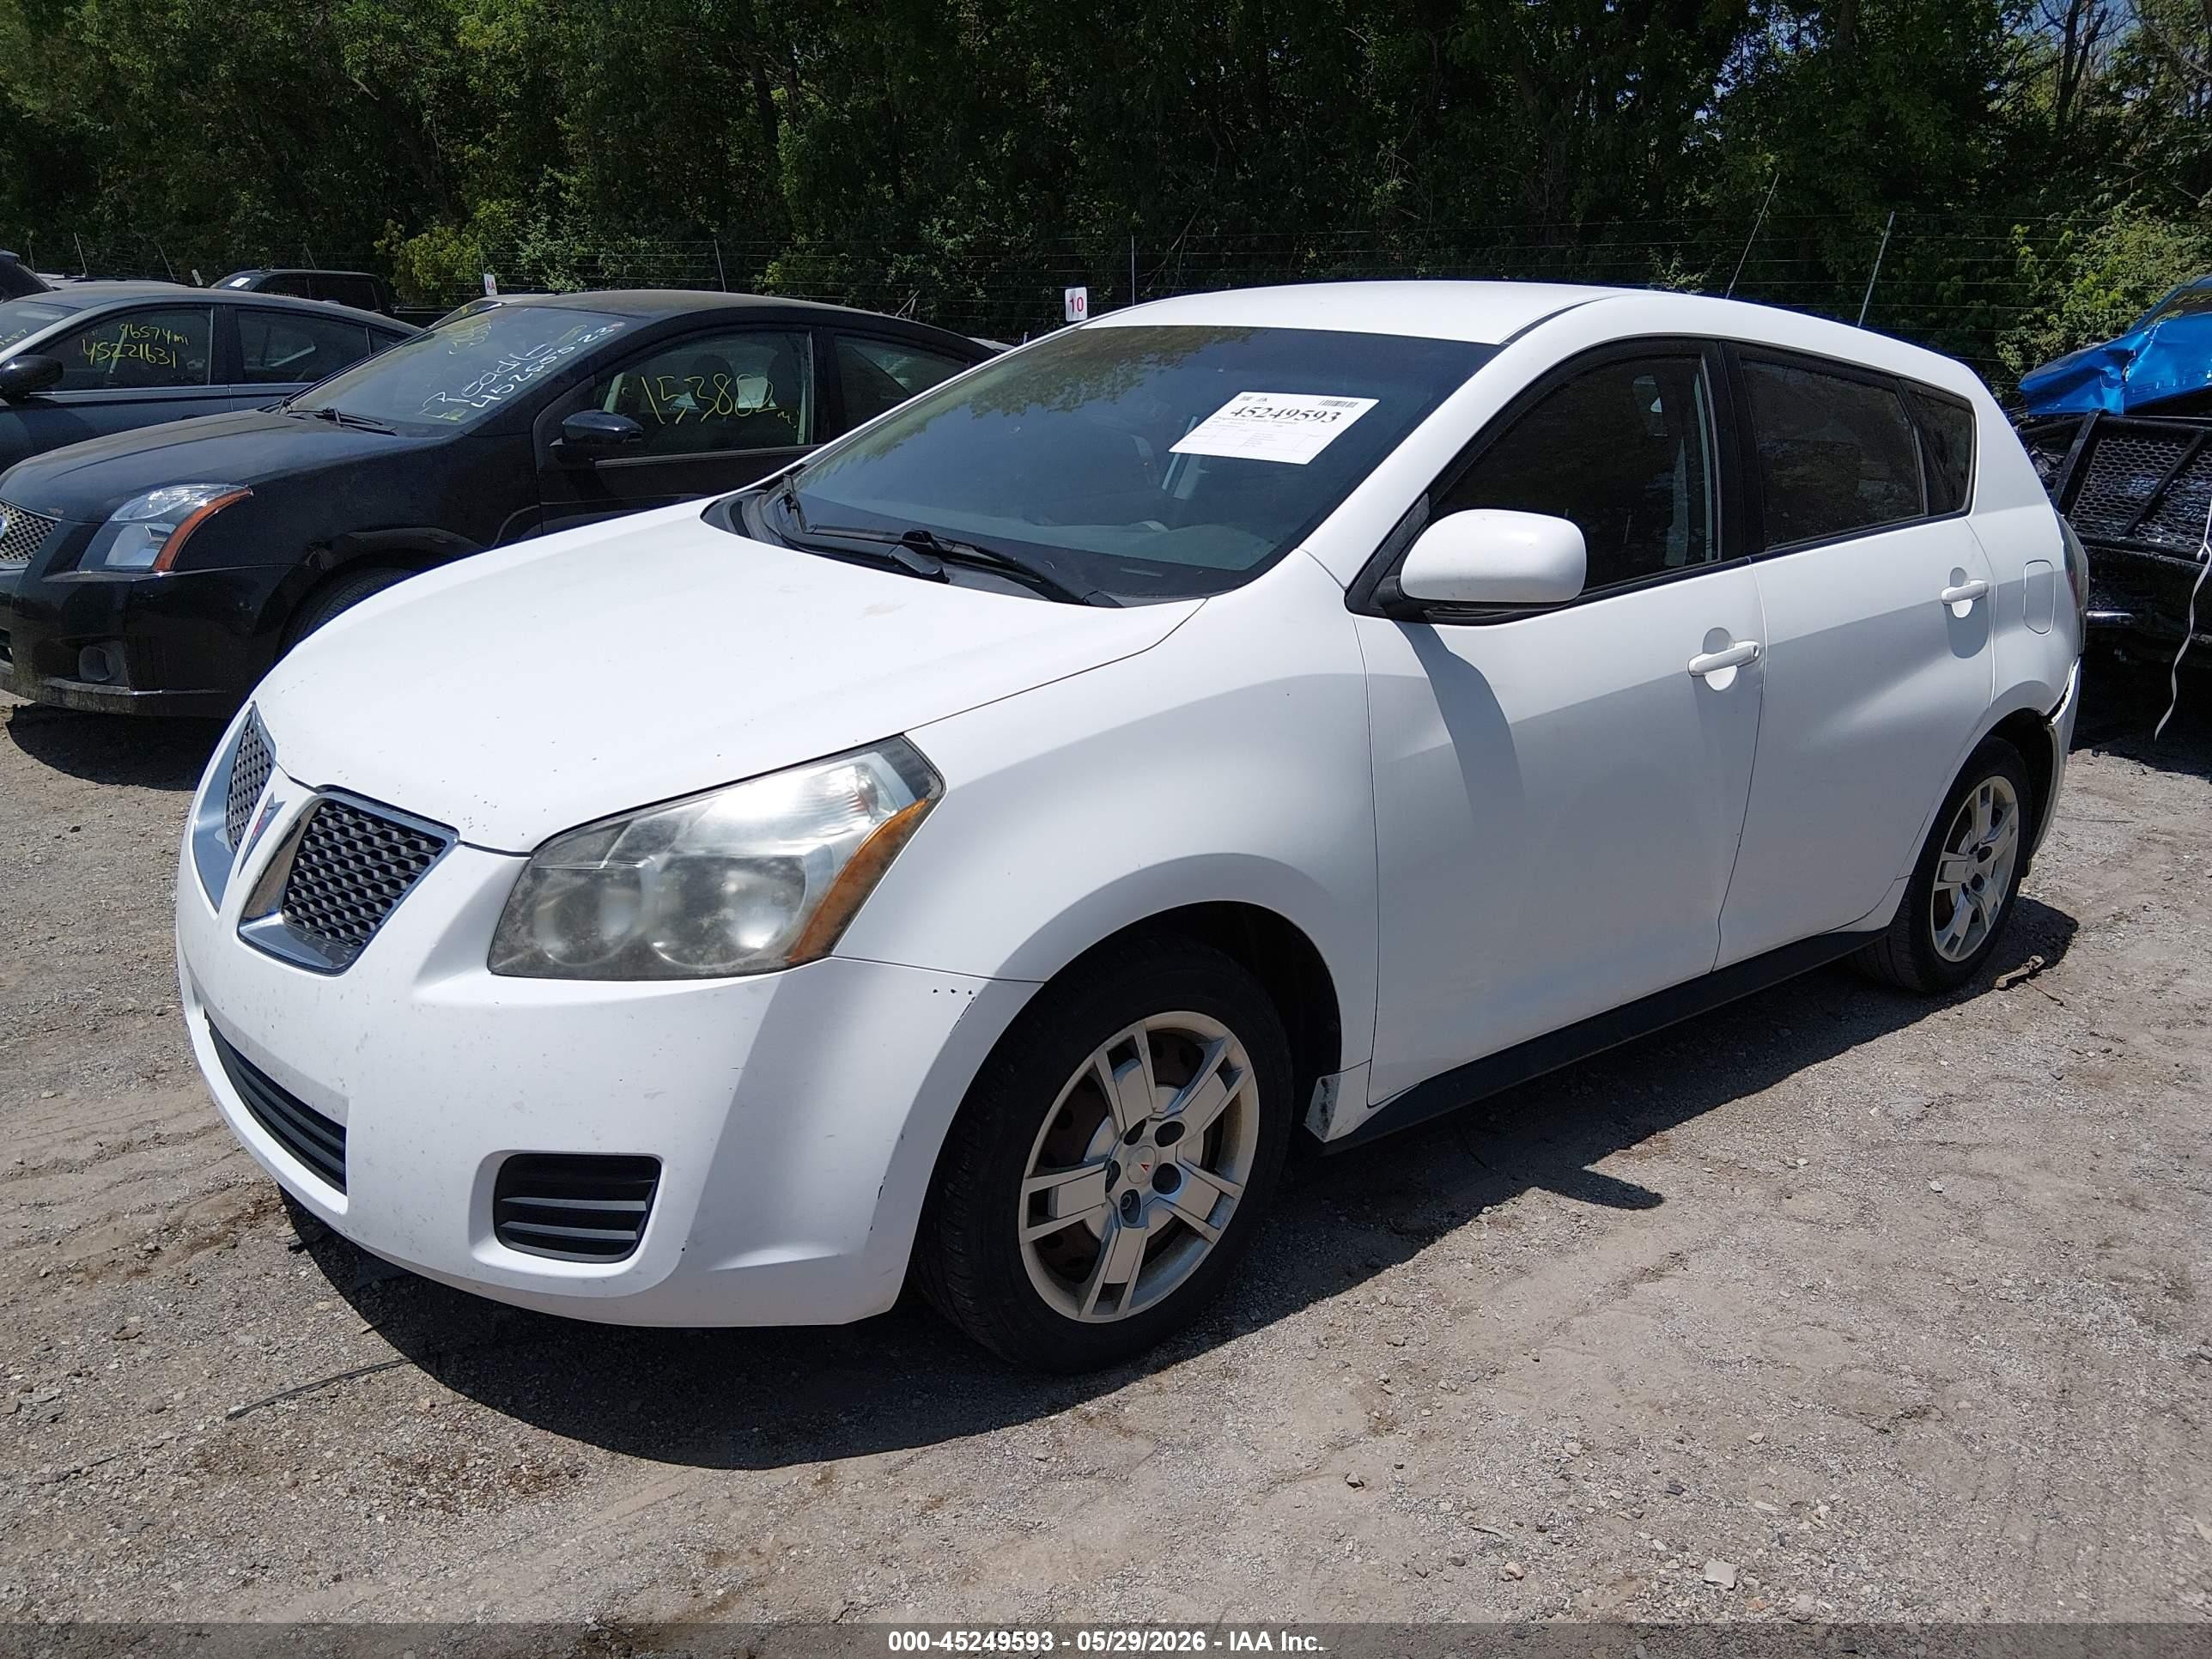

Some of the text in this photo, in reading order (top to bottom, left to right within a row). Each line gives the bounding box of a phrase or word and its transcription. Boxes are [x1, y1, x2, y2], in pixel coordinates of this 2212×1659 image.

[1069, 296, 1084, 313] 10
[82, 338, 177, 369] 45221631
[1231, 405, 1342, 423] 45249593
